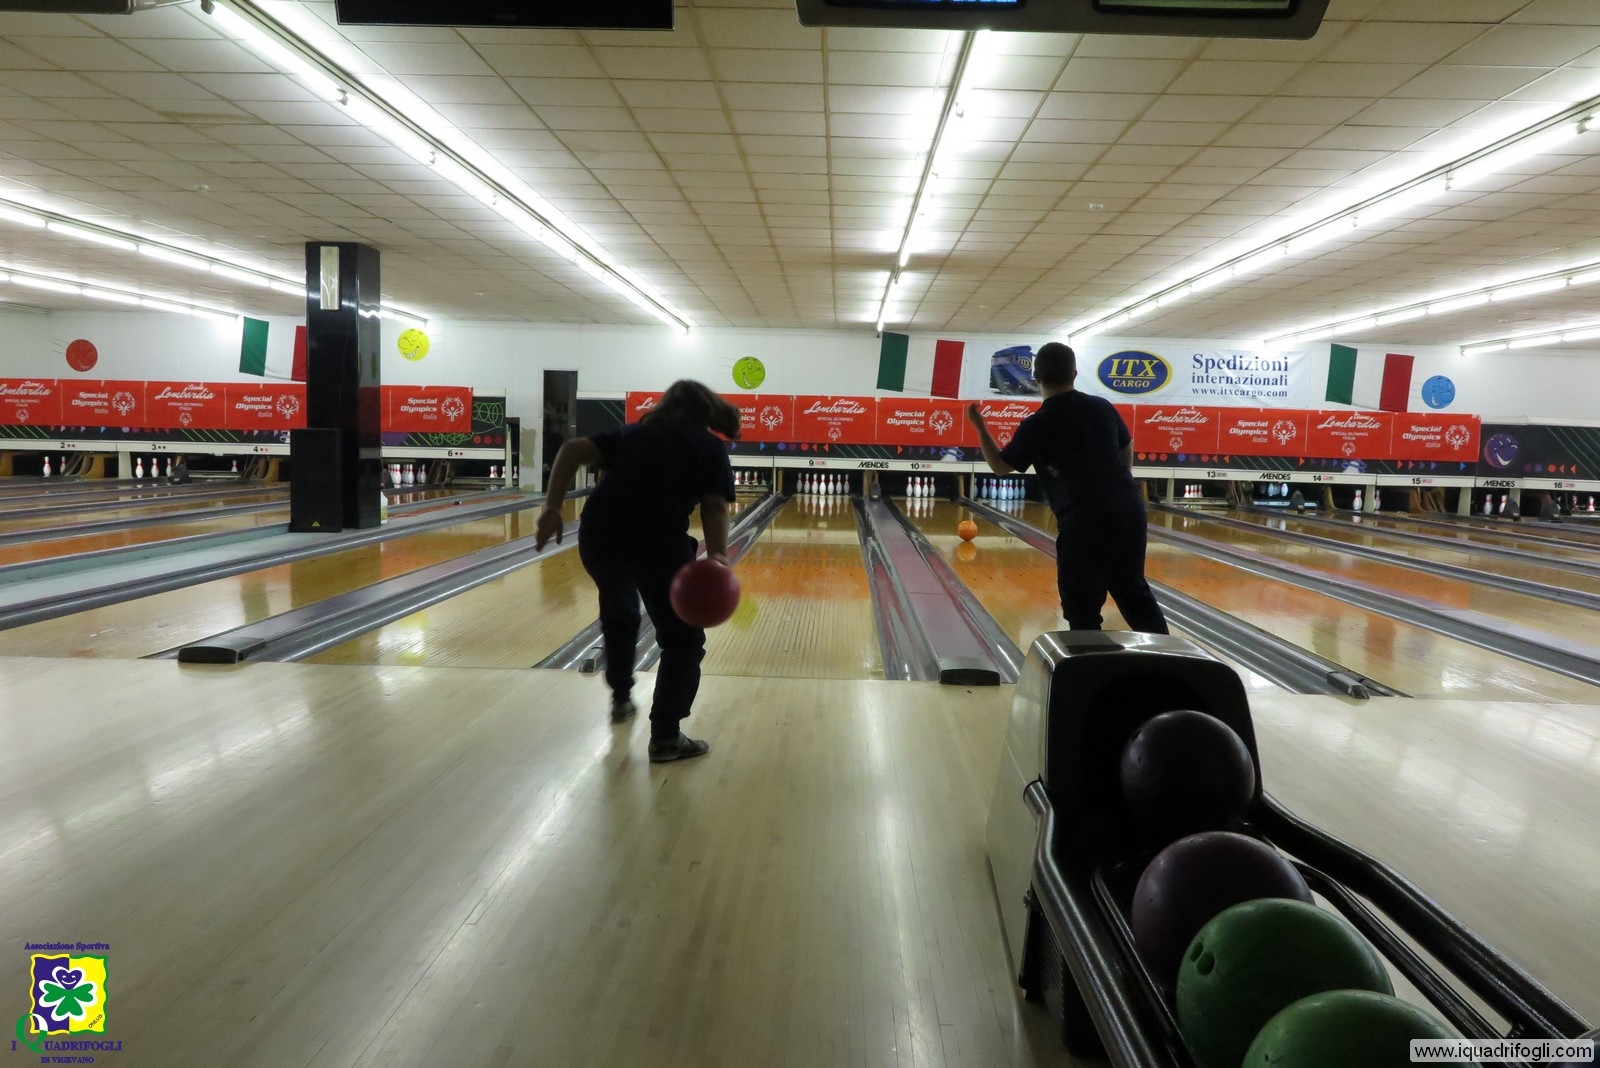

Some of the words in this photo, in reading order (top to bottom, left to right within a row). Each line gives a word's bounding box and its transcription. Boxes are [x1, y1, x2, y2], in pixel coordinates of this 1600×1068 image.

[1192, 353, 1289, 372] Spedizioni
[1108, 358, 1160, 377] ITX
[1112, 379, 1150, 388] CARGO
[1192, 373, 1288, 386] internazionali
[79, 391, 108, 399] Special
[154, 386, 216, 400] Lombardia
[1192, 387, 1288, 399] www.itxcargo.com
[72, 399, 108, 407] Olympics
[243, 395, 272, 403] Special
[408, 397, 438, 405] Special
[235, 403, 272, 411] Olympics
[400, 405, 438, 414] Olympics
[803, 400, 867, 414] Lombardia
[894, 410, 925, 418] Special
[980, 405, 1036, 418] Lombardi
[1144, 410, 1209, 424] Lombardia
[886, 418, 925, 426] Olympics
[1237, 420, 1268, 428] Special
[1317, 415, 1382, 429] Lombardia
[1229, 428, 1268, 436] Olympics
[1410, 425, 1442, 433] Special
[1402, 433, 1441, 441] Olympics
[1483, 480, 1515, 488] MENDES
